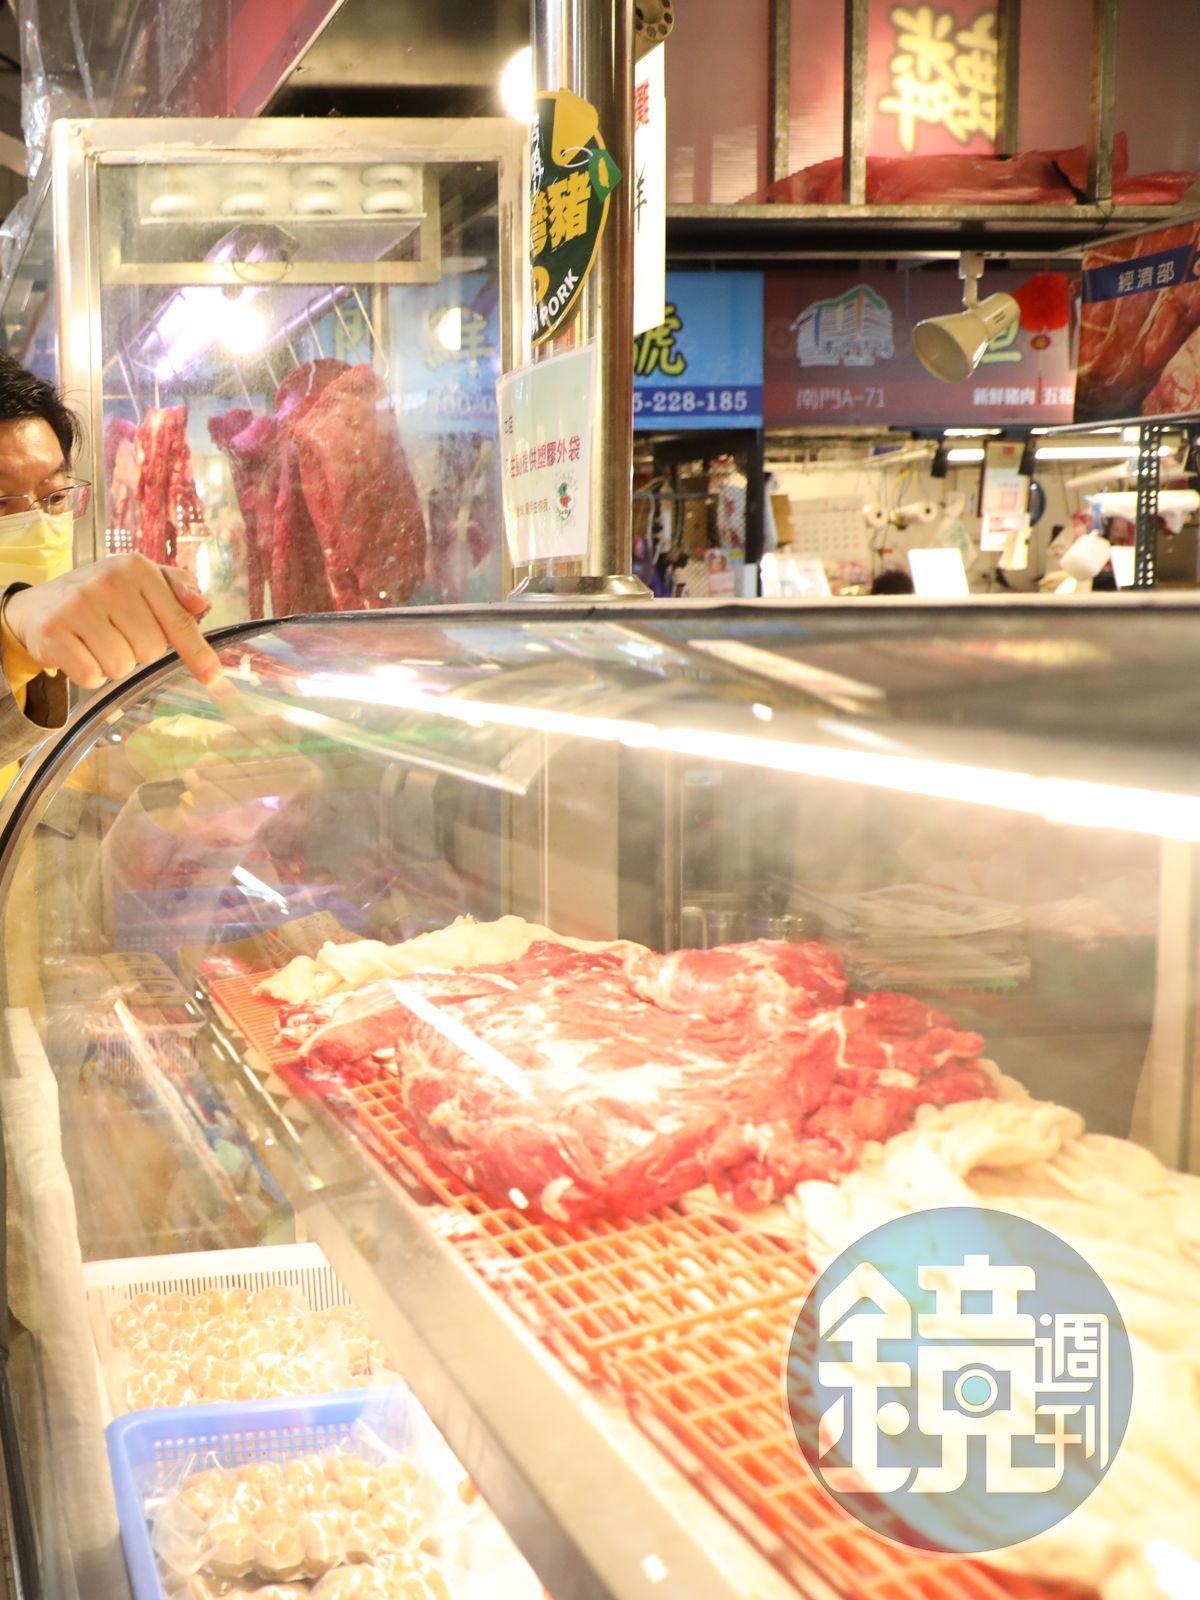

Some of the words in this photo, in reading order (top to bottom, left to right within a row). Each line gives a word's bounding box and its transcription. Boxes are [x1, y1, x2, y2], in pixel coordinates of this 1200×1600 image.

[539, 267, 580, 328] PORK
[1117, 260, 1175, 293] 經濟部
